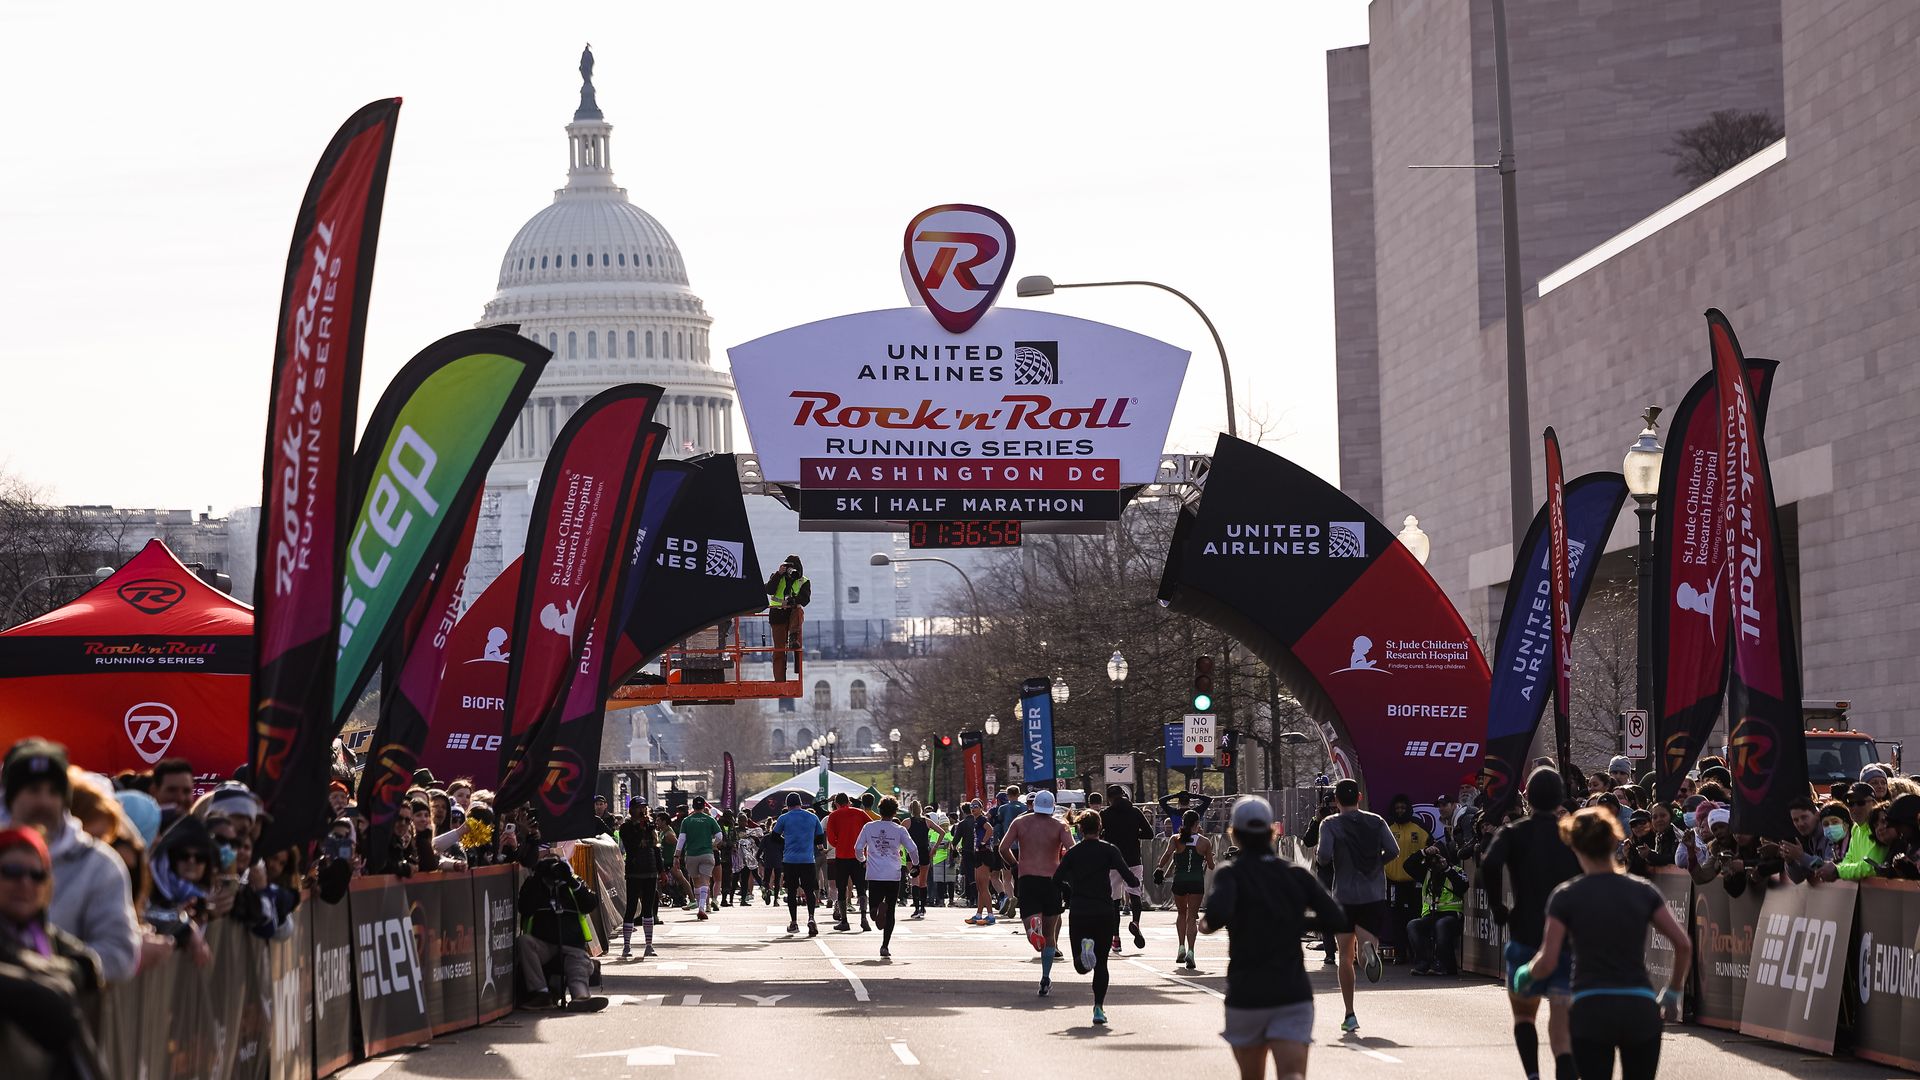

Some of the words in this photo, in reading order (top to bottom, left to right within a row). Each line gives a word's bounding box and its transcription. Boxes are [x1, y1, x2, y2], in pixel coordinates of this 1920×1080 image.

[887, 344, 1003, 361] UNITED
[857, 365, 1004, 382] AIRLINES
[298, 400, 323, 570] RUNNING
[314, 257, 341, 390] SERIES
[826, 438, 971, 457] RUNNING
[981, 439, 1094, 457] SERIES
[816, 466, 1044, 482] WASHINGTON
[1068, 466, 1106, 482] DC
[1726, 404, 1736, 521] RUNNING
[1687, 449, 1705, 514] Children's
[1701, 451, 1718, 507] Hospital
[558, 473, 581, 537] Children's
[835, 497, 863, 512] 5K
[890, 497, 947, 512] HALF
[963, 498, 1084, 513] MARATHON
[561, 531, 581, 586] Research
[573, 475, 594, 528] Hospital
[911, 520, 1020, 547] 01:36:58
[1226, 524, 1321, 538] UNITED
[1684, 517, 1697, 547] Jude
[1695, 508, 1712, 566] Research
[552, 540, 567, 568] Jude
[1203, 541, 1321, 555] AIRLINES
[1512, 580, 1551, 673] UNITED
[1385, 640, 1398, 649] St.
[1398, 640, 1420, 650] Jude
[1421, 640, 1469, 649] Children's
[1386, 651, 1427, 659] Research
[1429, 651, 1468, 662] Hospital
[1520, 603, 1552, 701] AIRLIN
[95, 657, 155, 665] RUNNING
[158, 657, 205, 665] SERIES
[1193, 717, 1208, 725] NO
[1029, 707, 1044, 770] WATER
